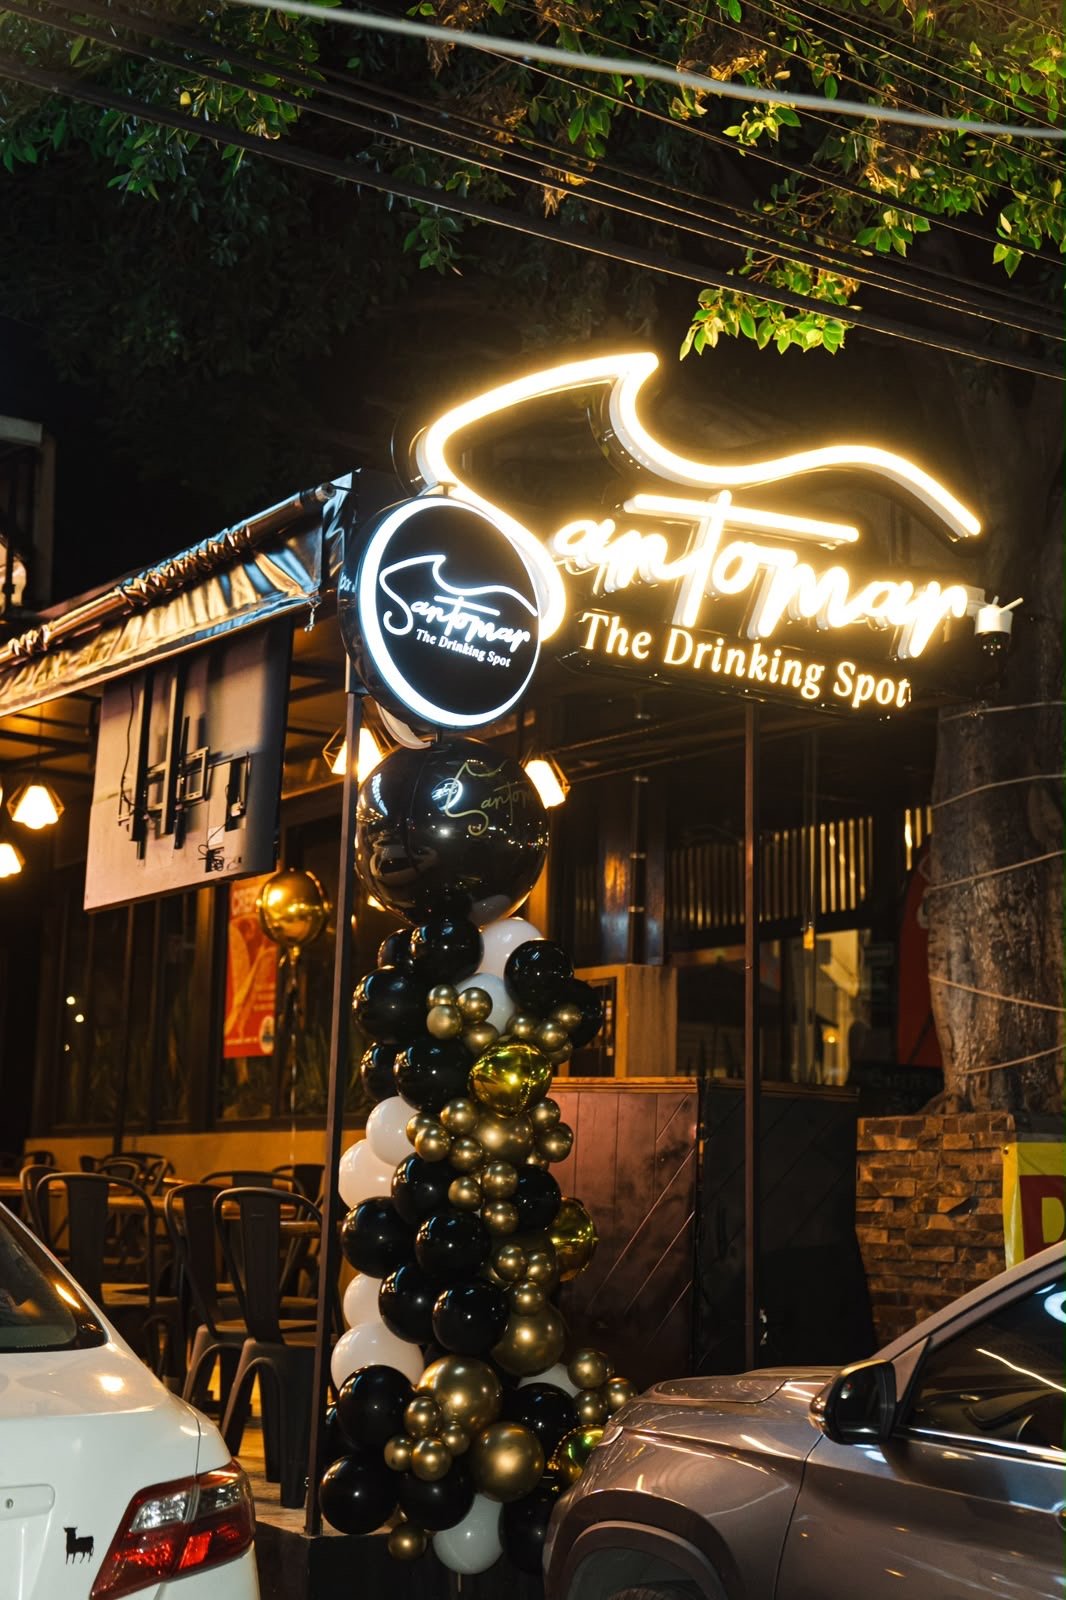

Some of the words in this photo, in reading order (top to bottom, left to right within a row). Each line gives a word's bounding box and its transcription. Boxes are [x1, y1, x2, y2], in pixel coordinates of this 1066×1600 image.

[416, 628, 437, 645] The
[438, 635, 487, 662] Drinking
[487, 650, 511, 668] Spot
[579, 611, 650, 659] The
[663, 628, 826, 699] Drinking
[834, 661, 911, 708] Spot
